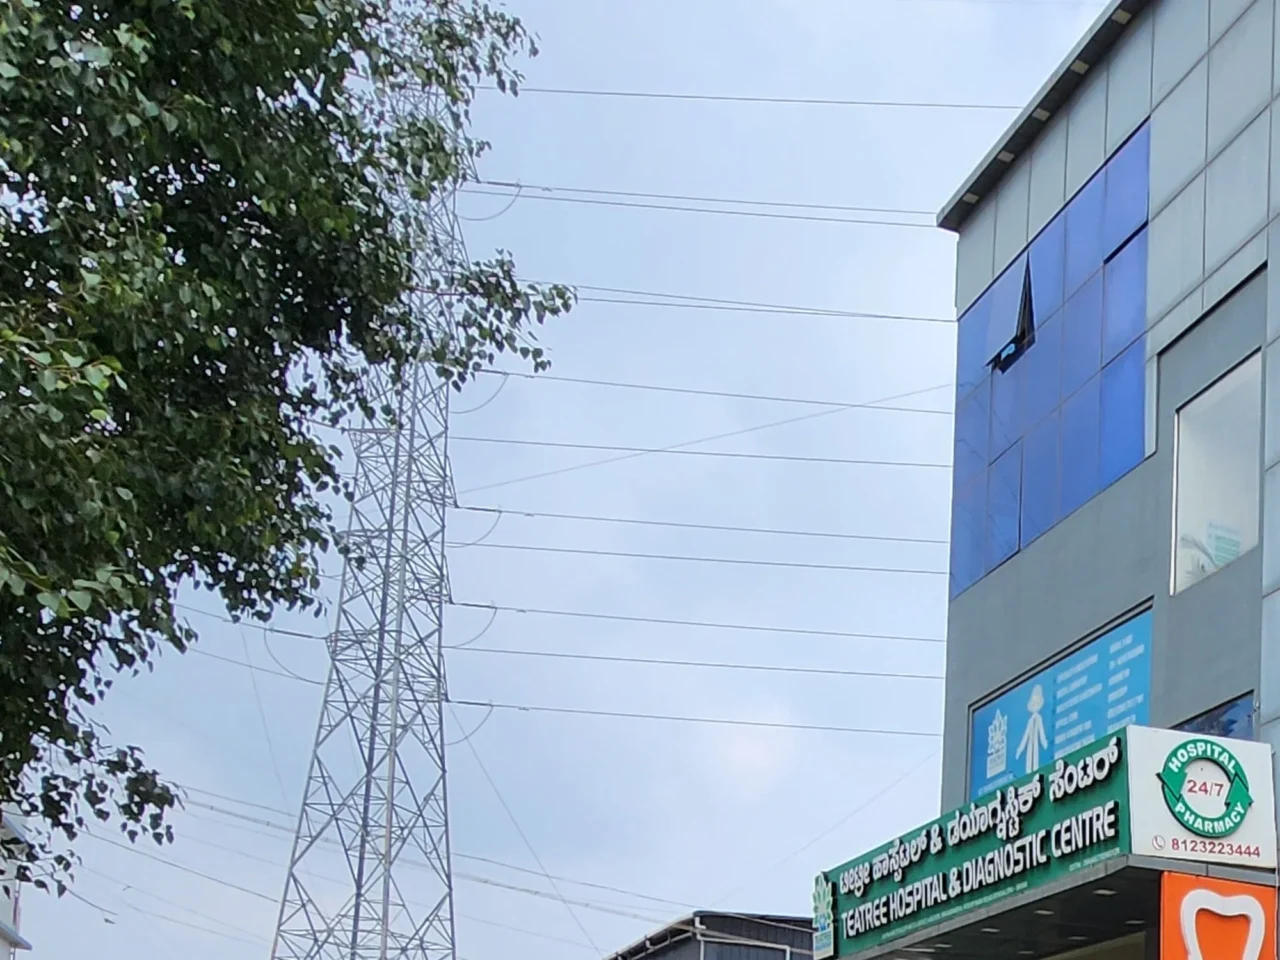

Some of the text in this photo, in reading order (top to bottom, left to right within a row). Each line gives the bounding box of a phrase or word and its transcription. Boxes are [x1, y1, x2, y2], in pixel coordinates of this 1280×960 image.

[1168, 741, 1236, 773] HOSPITAL
[1186, 779, 1224, 797] 24/7
[1174, 802, 1245, 833] PHARMACY
[929, 823, 943, 854] &
[1171, 837, 1261, 858] 8123223444
[841, 897, 888, 940] TEATREE
[889, 871, 948, 922] HOSPITAL
[948, 866, 963, 899] &
[962, 829, 1047, 894] DIAGNOSTIC
[1050, 800, 1117, 859] CENTRE
